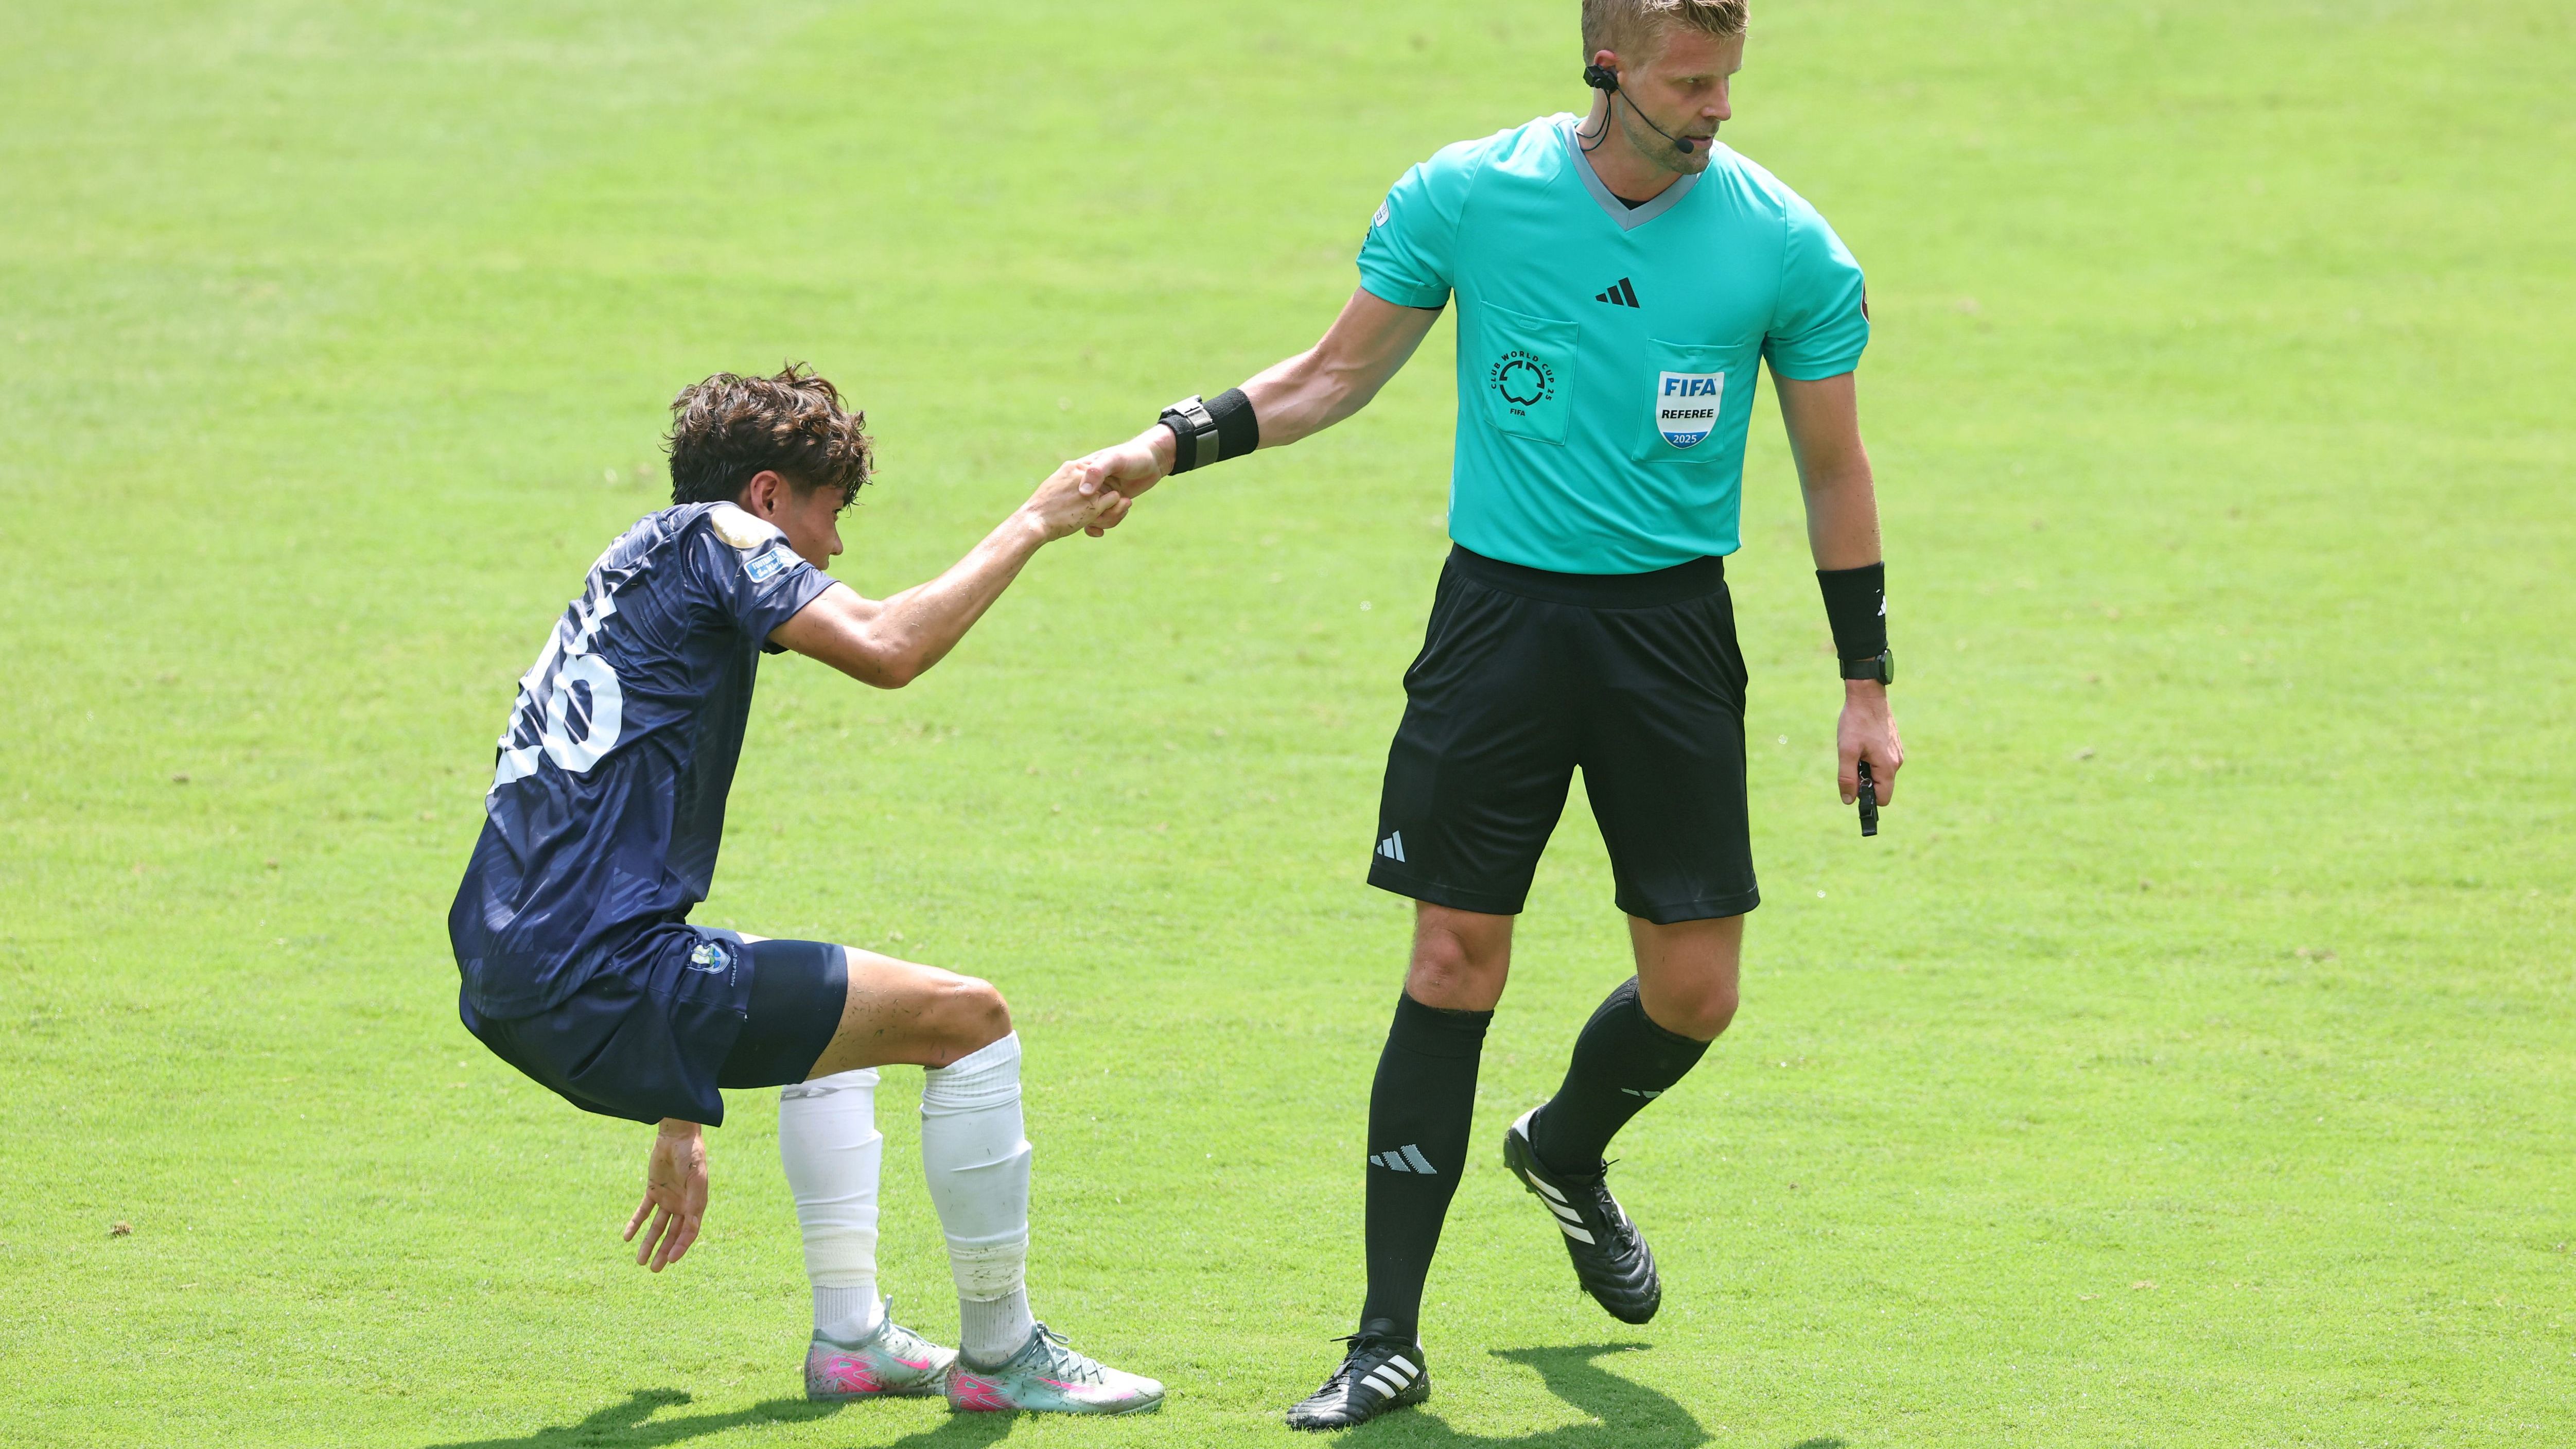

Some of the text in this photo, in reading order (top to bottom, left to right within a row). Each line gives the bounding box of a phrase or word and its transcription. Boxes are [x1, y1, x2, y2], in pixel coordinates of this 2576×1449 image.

[1491, 351, 1554, 401] CLUB WORLD CUP 25
[1664, 378, 1716, 396] FIFA
[1510, 408, 1526, 416] FIFA
[1661, 409, 1714, 419] REFEREE
[1673, 434, 1697, 443] 2025
[752, 552, 778, 570] FOOTBALL
[767, 557, 782, 573] Worl
